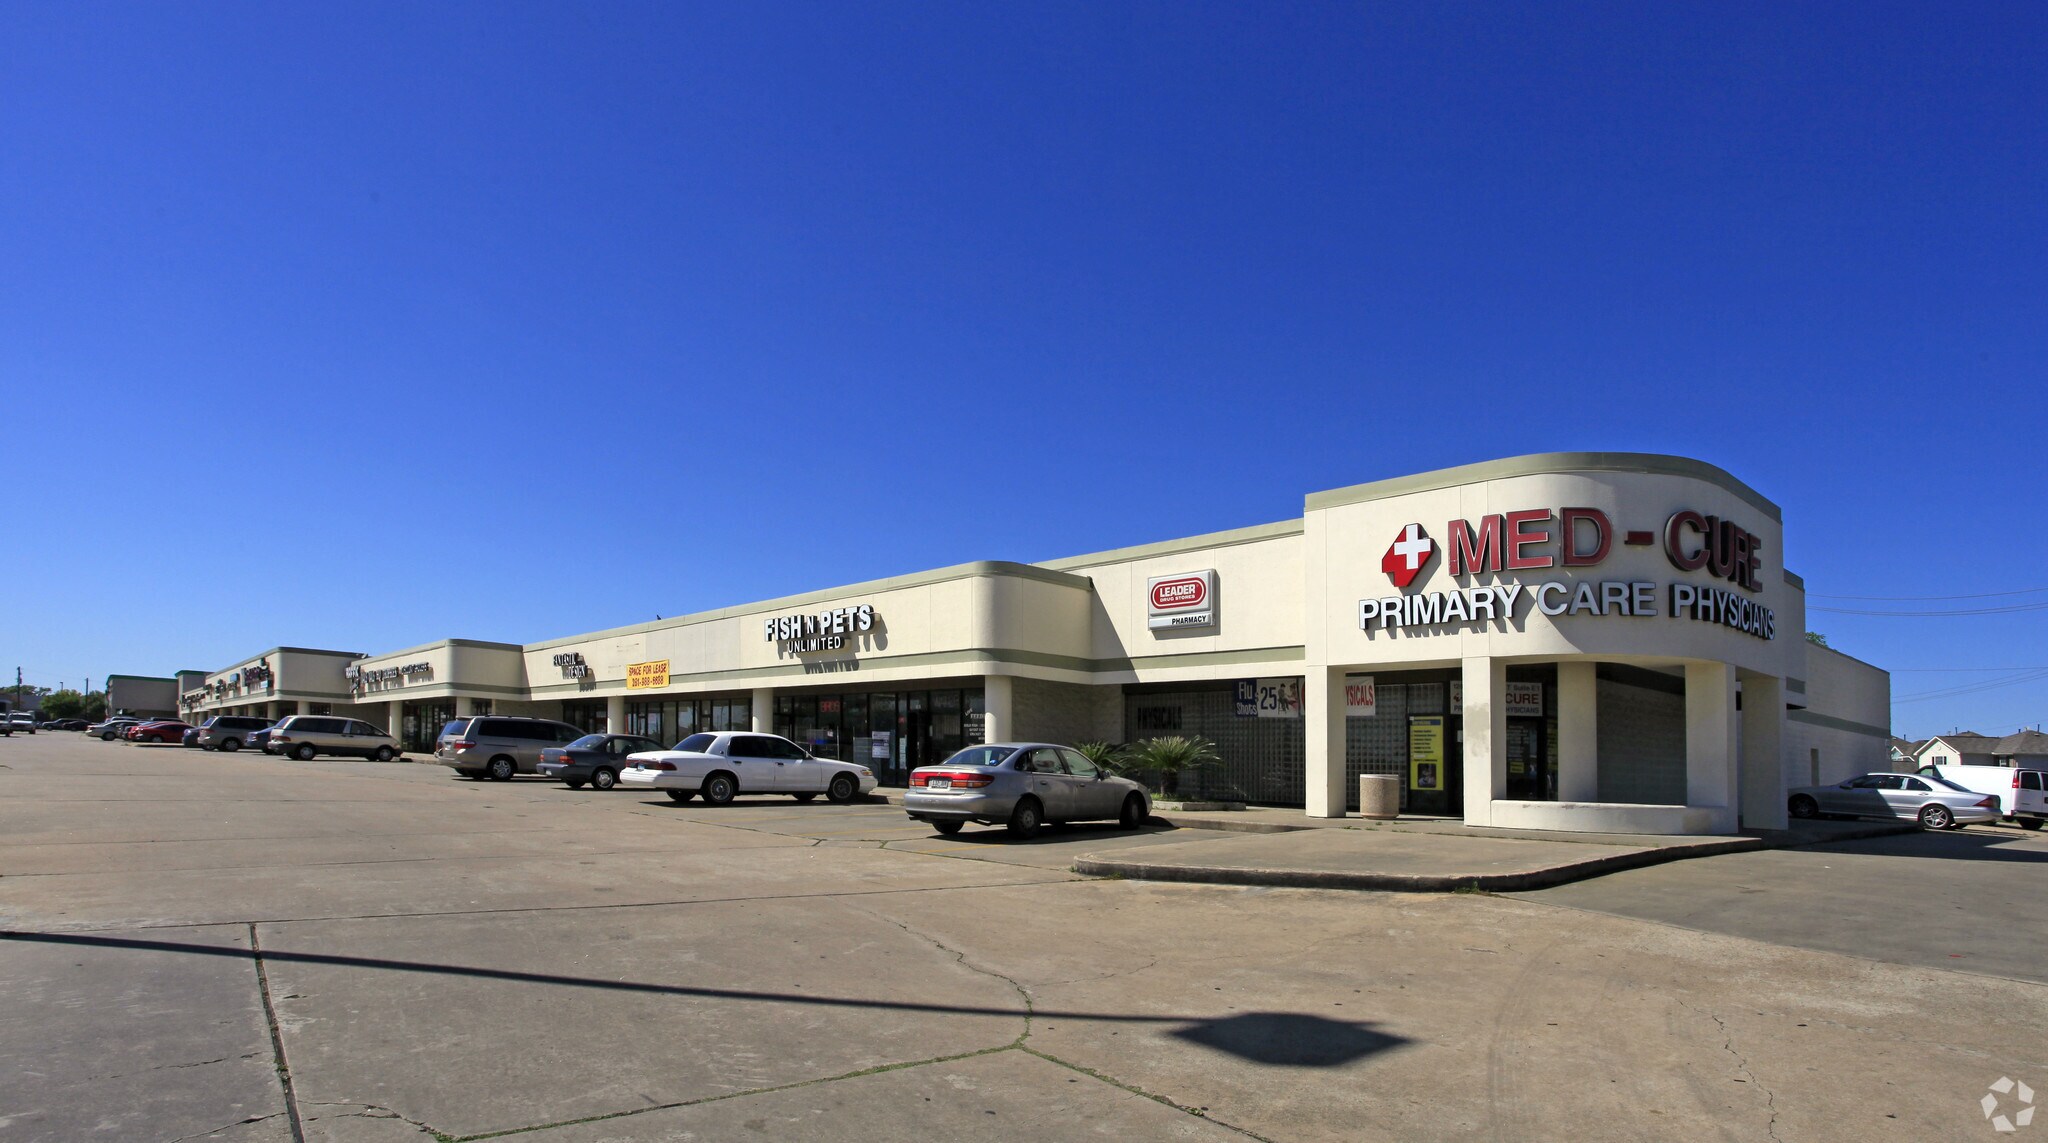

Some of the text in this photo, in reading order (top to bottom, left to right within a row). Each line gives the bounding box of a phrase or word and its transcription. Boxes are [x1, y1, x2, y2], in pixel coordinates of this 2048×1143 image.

[1159, 584, 1196, 598] LEADER
[1359, 582, 1776, 640] PRIMARY CARE PHYSICIANS
[764, 604, 874, 642] FISH N PETS
[1171, 614, 1207, 625] PHARMACY
[788, 635, 844, 654] UNLIMITED
[628, 663, 667, 677] SPACE FOR LEASE
[1238, 681, 1253, 700] Flu
[1345, 684, 1374, 706] YSICALS
[1236, 702, 1258, 716] Shots
[1506, 706, 1540, 714] HYSICIANS
